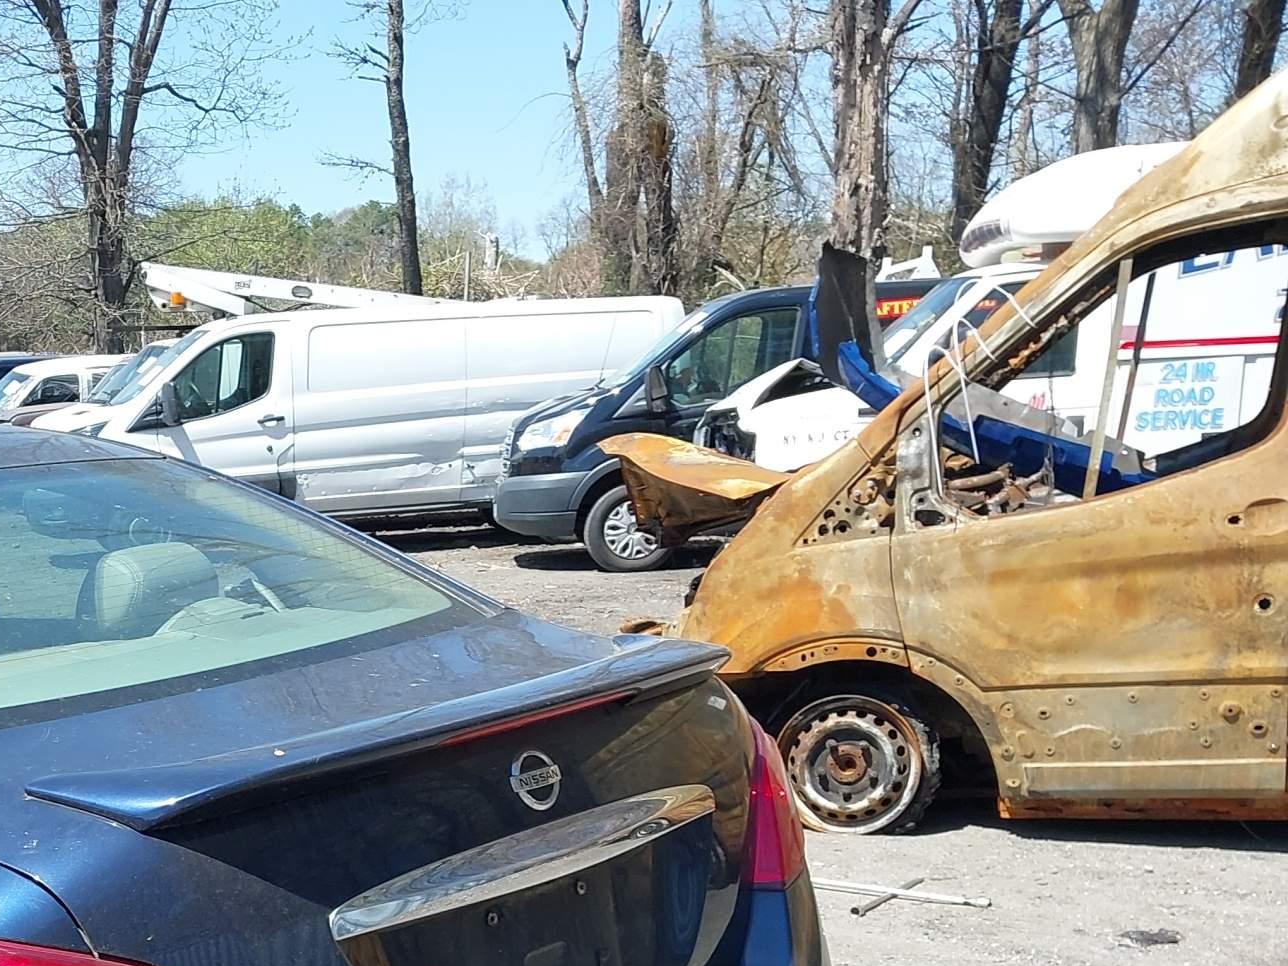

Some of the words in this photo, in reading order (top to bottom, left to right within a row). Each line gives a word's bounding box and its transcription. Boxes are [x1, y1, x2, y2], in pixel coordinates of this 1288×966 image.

[1160, 363, 1187, 384] 24
[1154, 386, 1215, 408] ROAD
[1134, 407, 1225, 432] SERVICE
[519, 768, 559, 788] NISSAN
